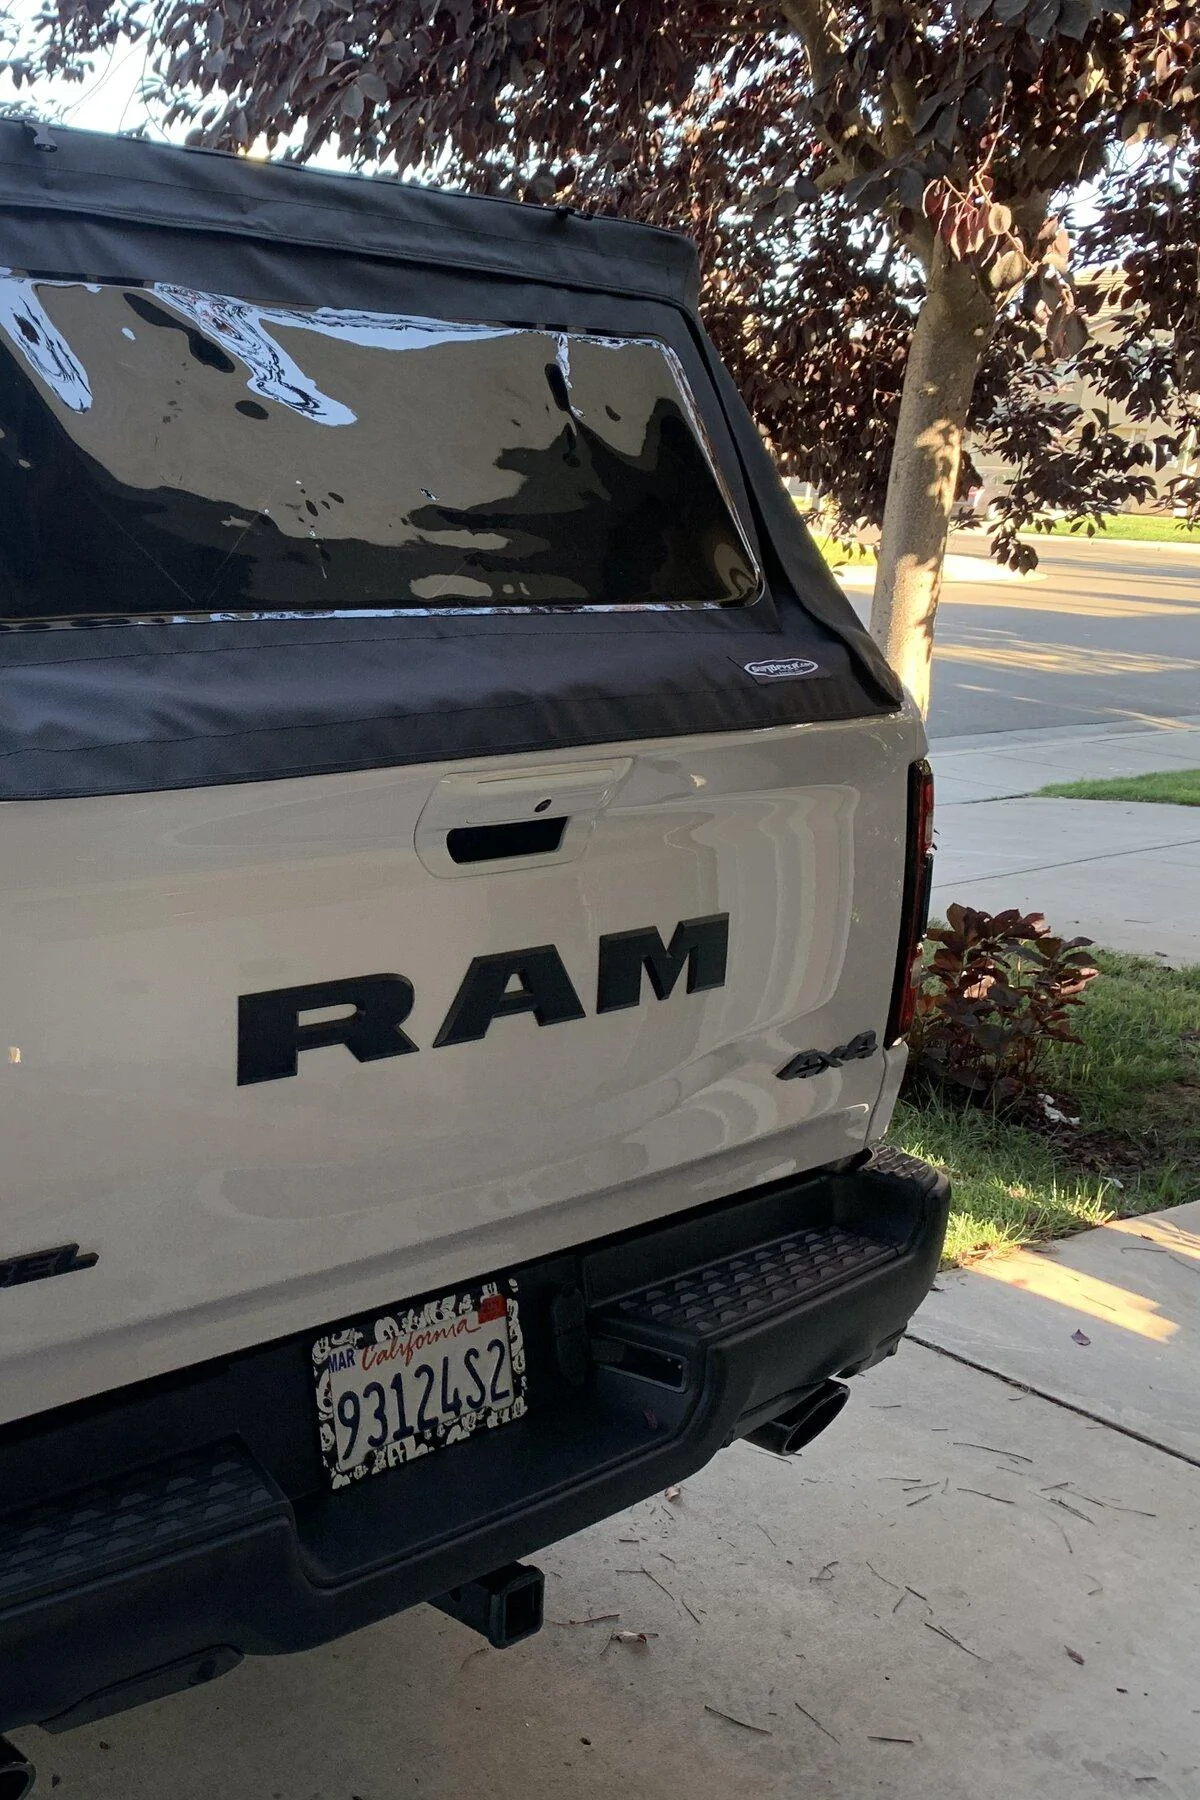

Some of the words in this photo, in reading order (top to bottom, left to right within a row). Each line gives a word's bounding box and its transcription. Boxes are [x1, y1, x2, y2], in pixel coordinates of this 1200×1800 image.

[237, 912, 730, 1086] RAM
[328, 1348, 355, 1373] MAR
[362, 1319, 481, 1371] California
[337, 1338, 510, 1461] 93124S2
